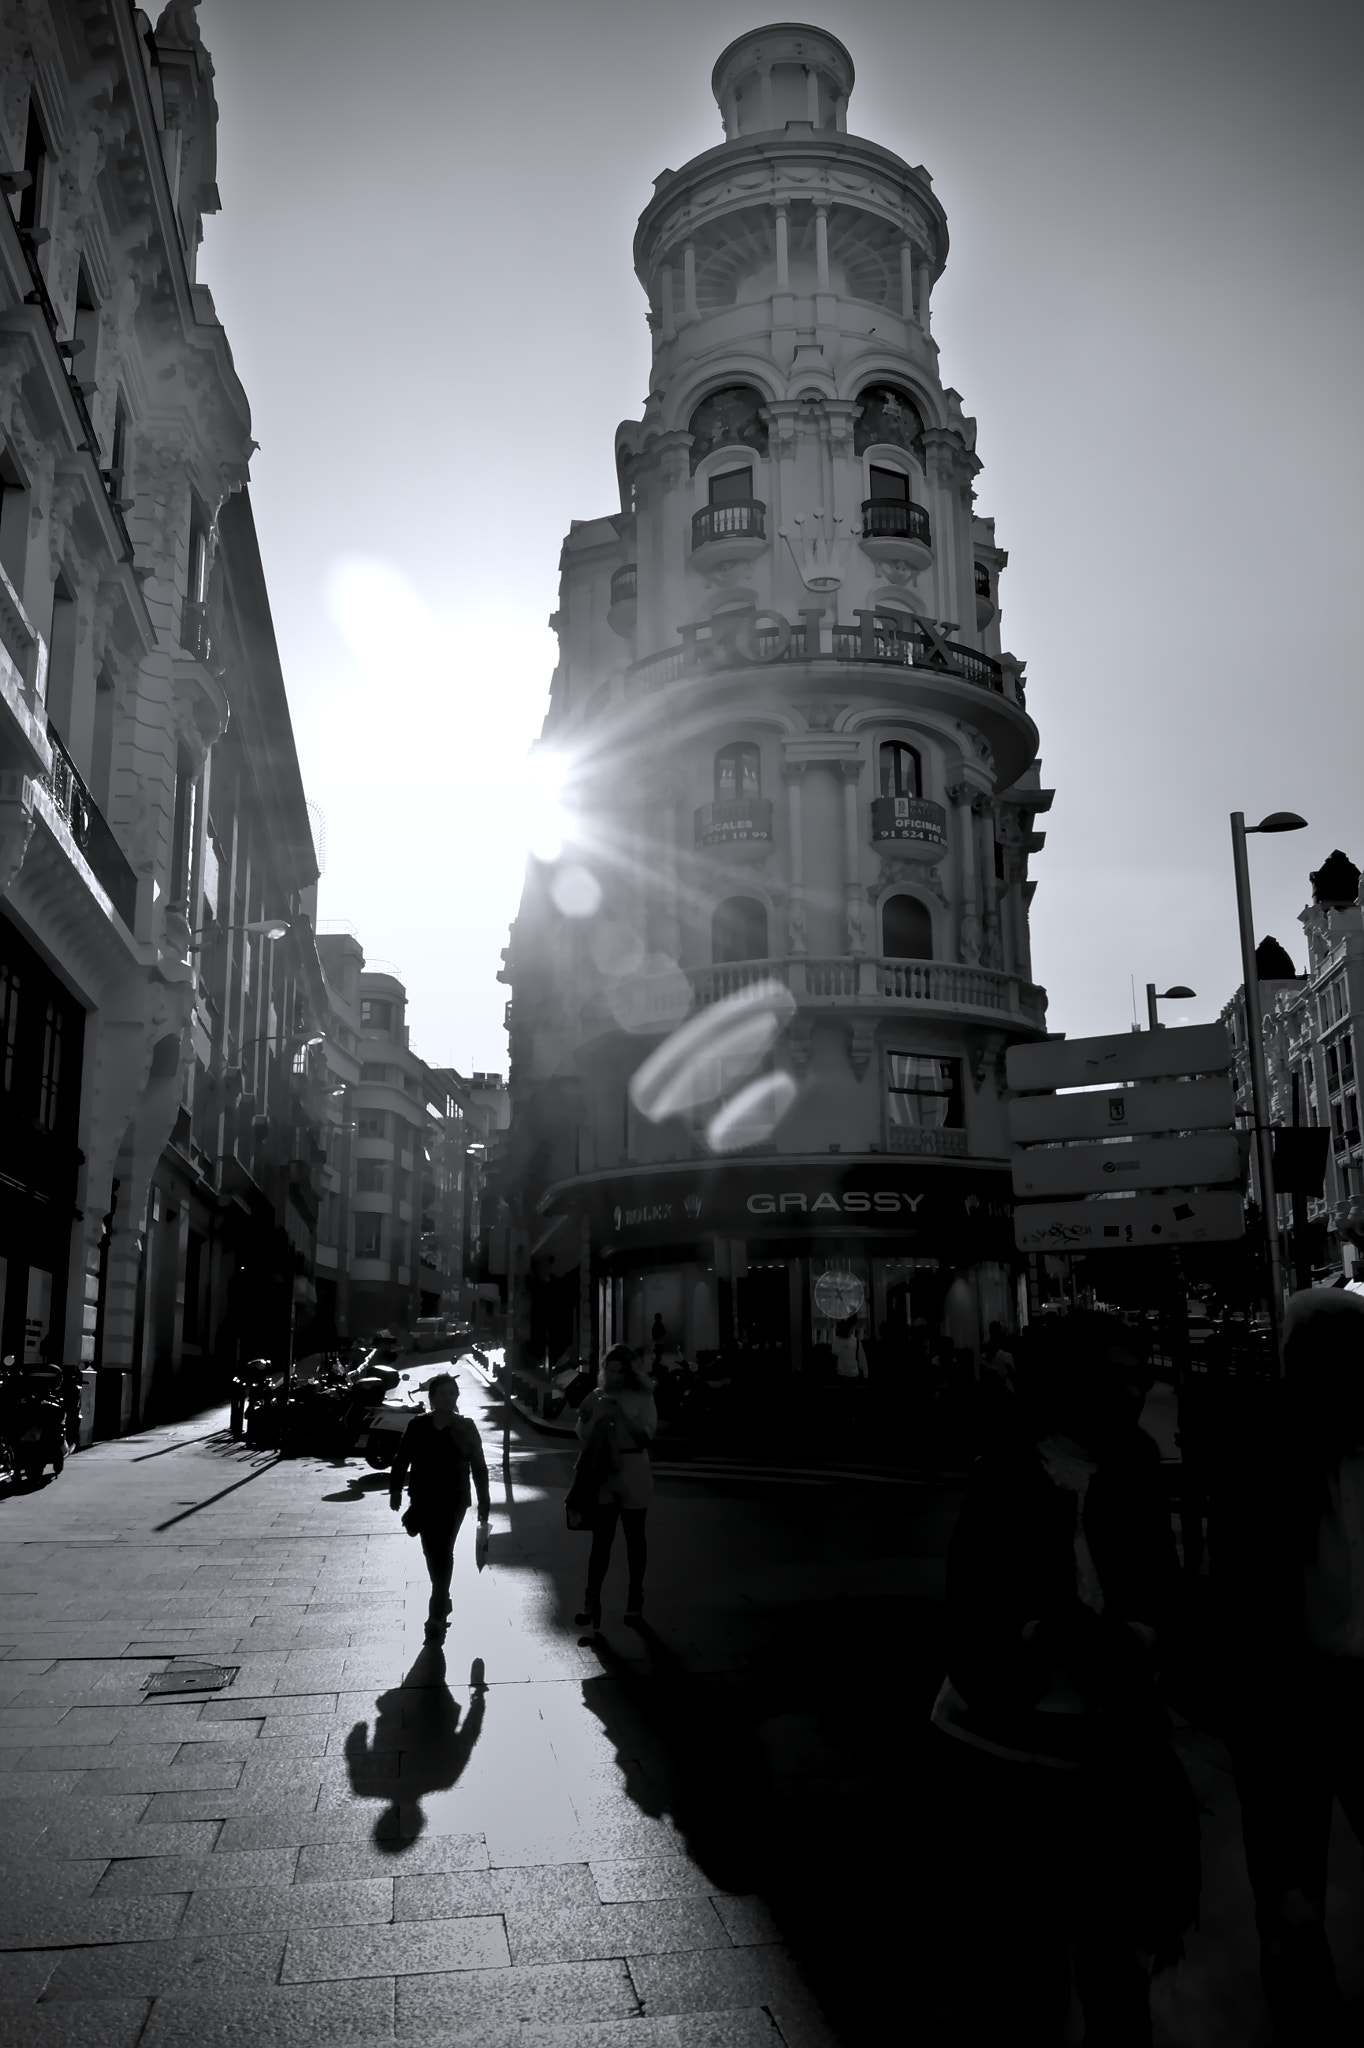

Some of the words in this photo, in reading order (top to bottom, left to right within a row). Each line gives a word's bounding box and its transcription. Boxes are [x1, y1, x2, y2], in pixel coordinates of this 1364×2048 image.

[676, 608, 961, 669] ROLEX
[880, 830, 896, 838] 91
[901, 830, 924, 839] 524
[895, 819, 942, 833] OFICINAS
[746, 1191, 925, 1214] GRASSY
